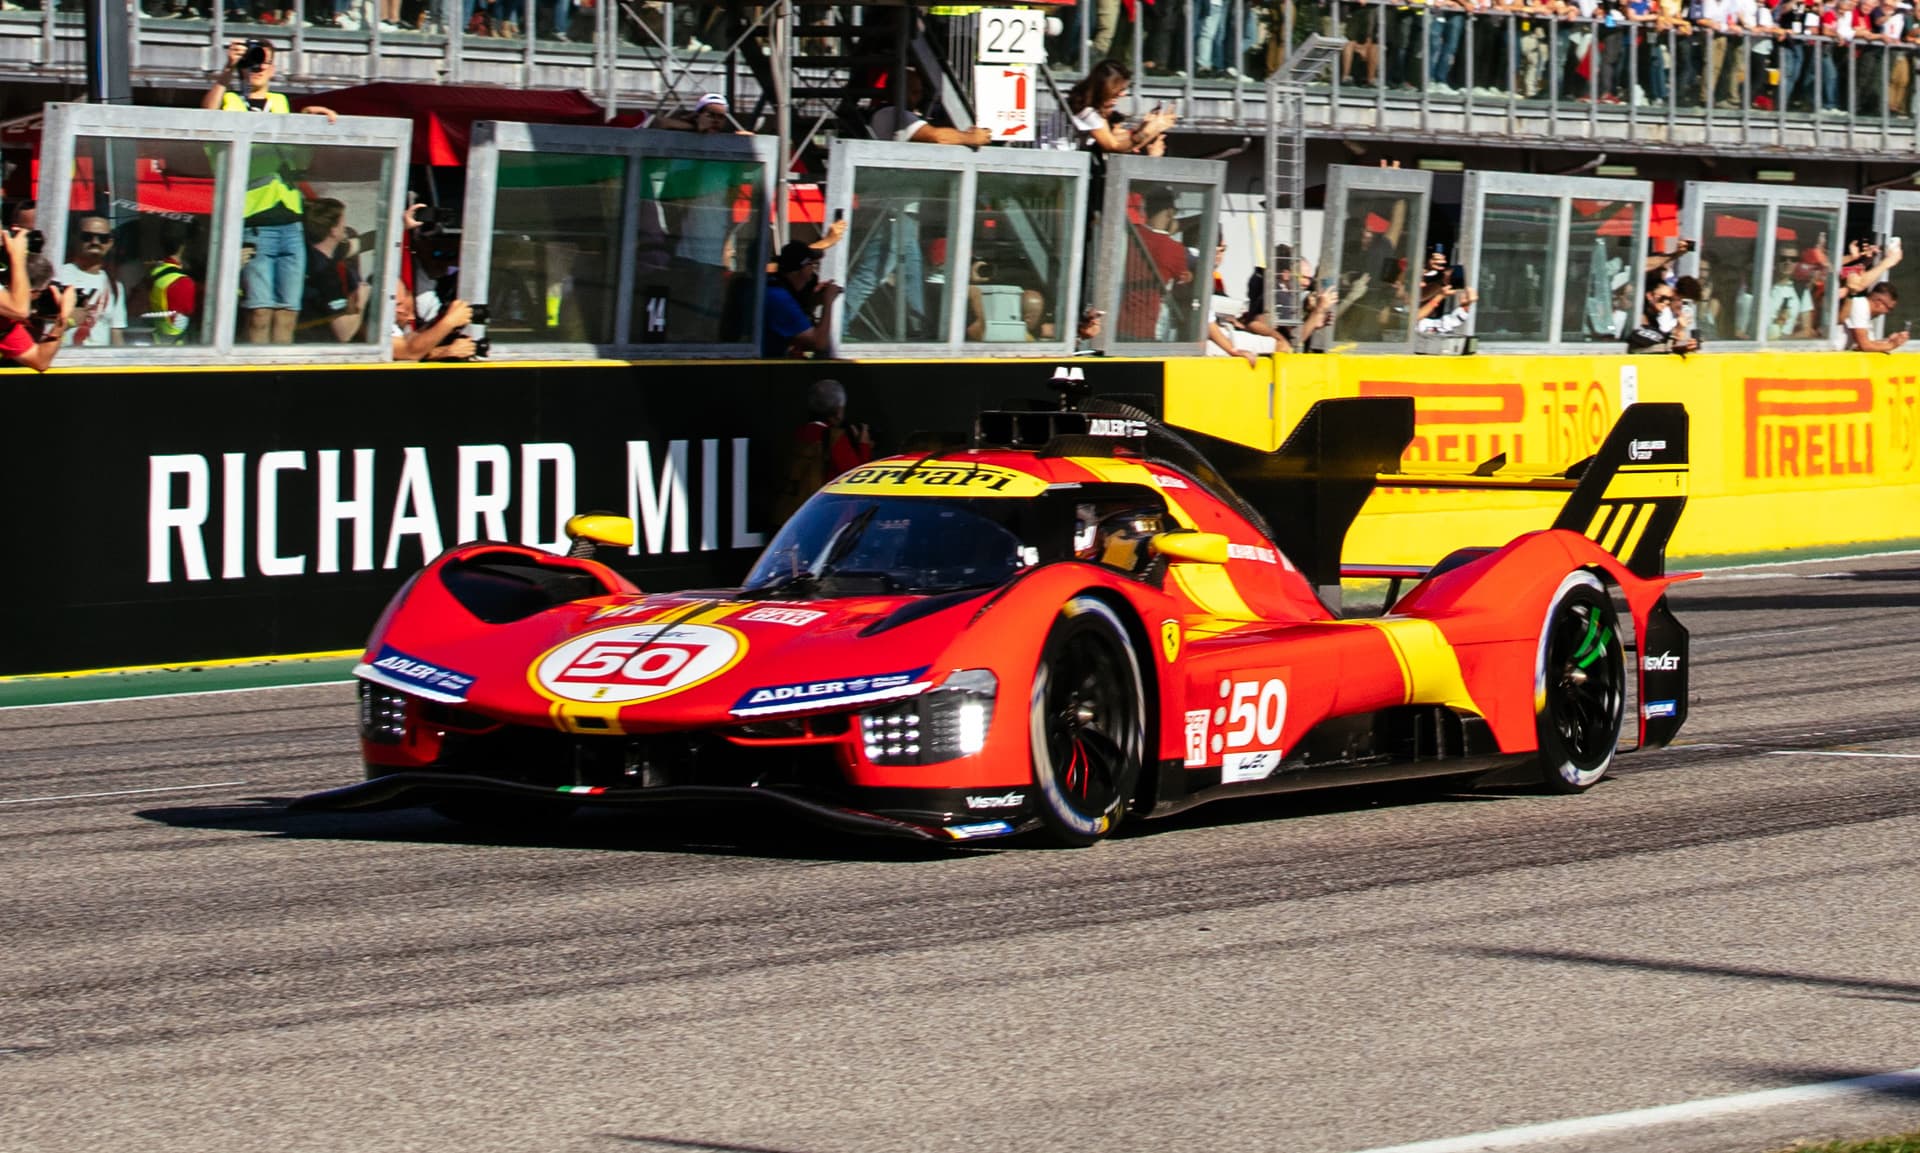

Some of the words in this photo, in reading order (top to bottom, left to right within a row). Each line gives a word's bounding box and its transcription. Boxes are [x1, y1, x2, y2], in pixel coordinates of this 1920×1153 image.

[1744, 377, 1873, 477] PIRELLI
[147, 442, 577, 583] RICHARD
[373, 656, 437, 679] ADLER
[566, 644, 691, 680] 50
[749, 681, 845, 703] ADLER
[1227, 679, 1288, 747] 50
